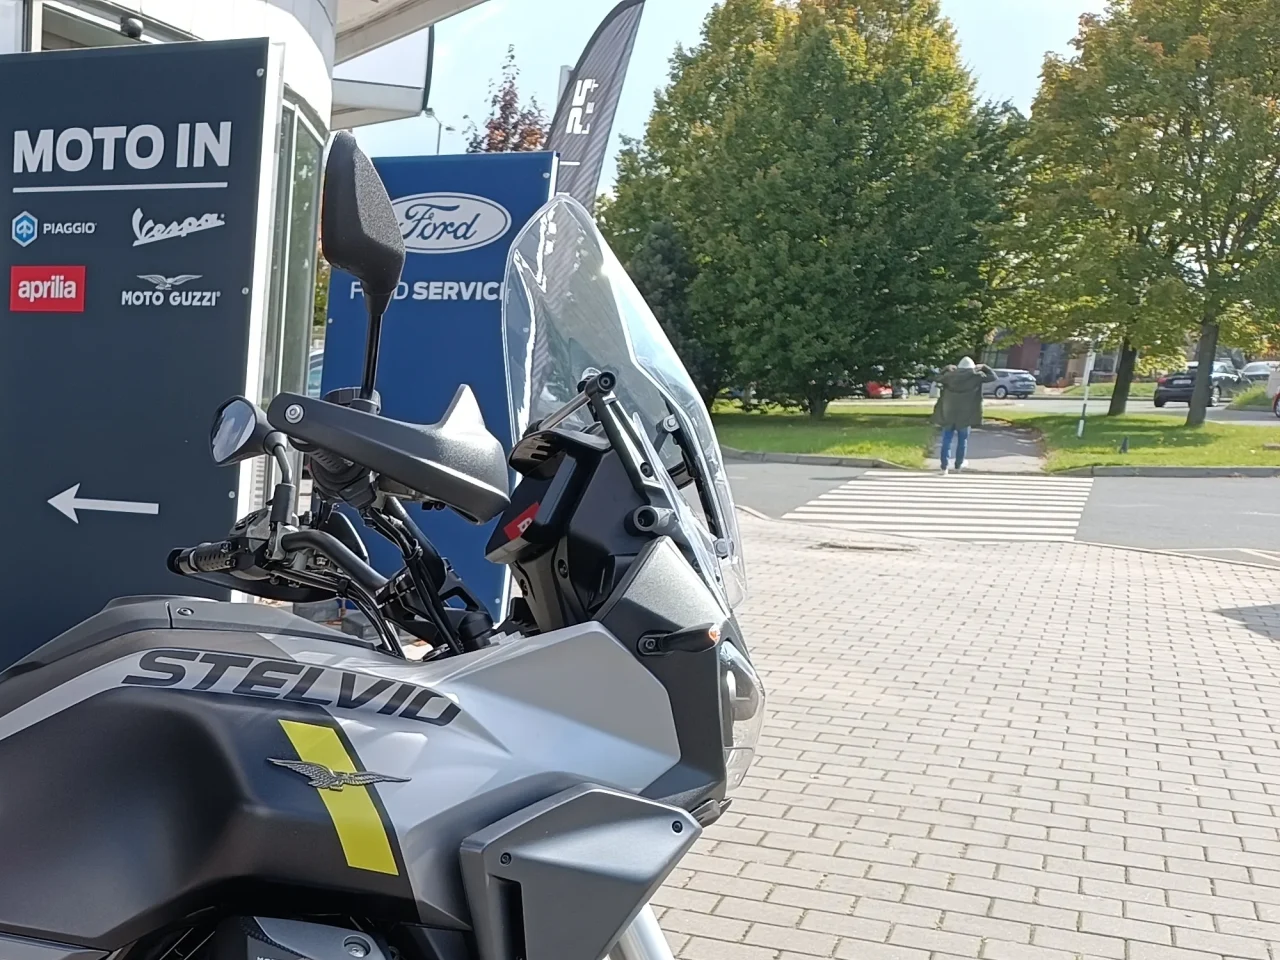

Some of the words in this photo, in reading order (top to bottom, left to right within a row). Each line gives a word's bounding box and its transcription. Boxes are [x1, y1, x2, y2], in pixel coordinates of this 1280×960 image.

[13, 124, 165, 173] MOTO
[176, 121, 232, 168] IN
[43, 222, 95, 234] PIAGGIO
[131, 207, 226, 247] Vespa
[400, 203, 481, 240] Ford
[18, 275, 76, 302] aprilia
[121, 290, 164, 306] MOTO
[169, 291, 217, 306] GUZZI
[350, 281, 409, 300] FD
[121, 649, 462, 727] STELVIO
